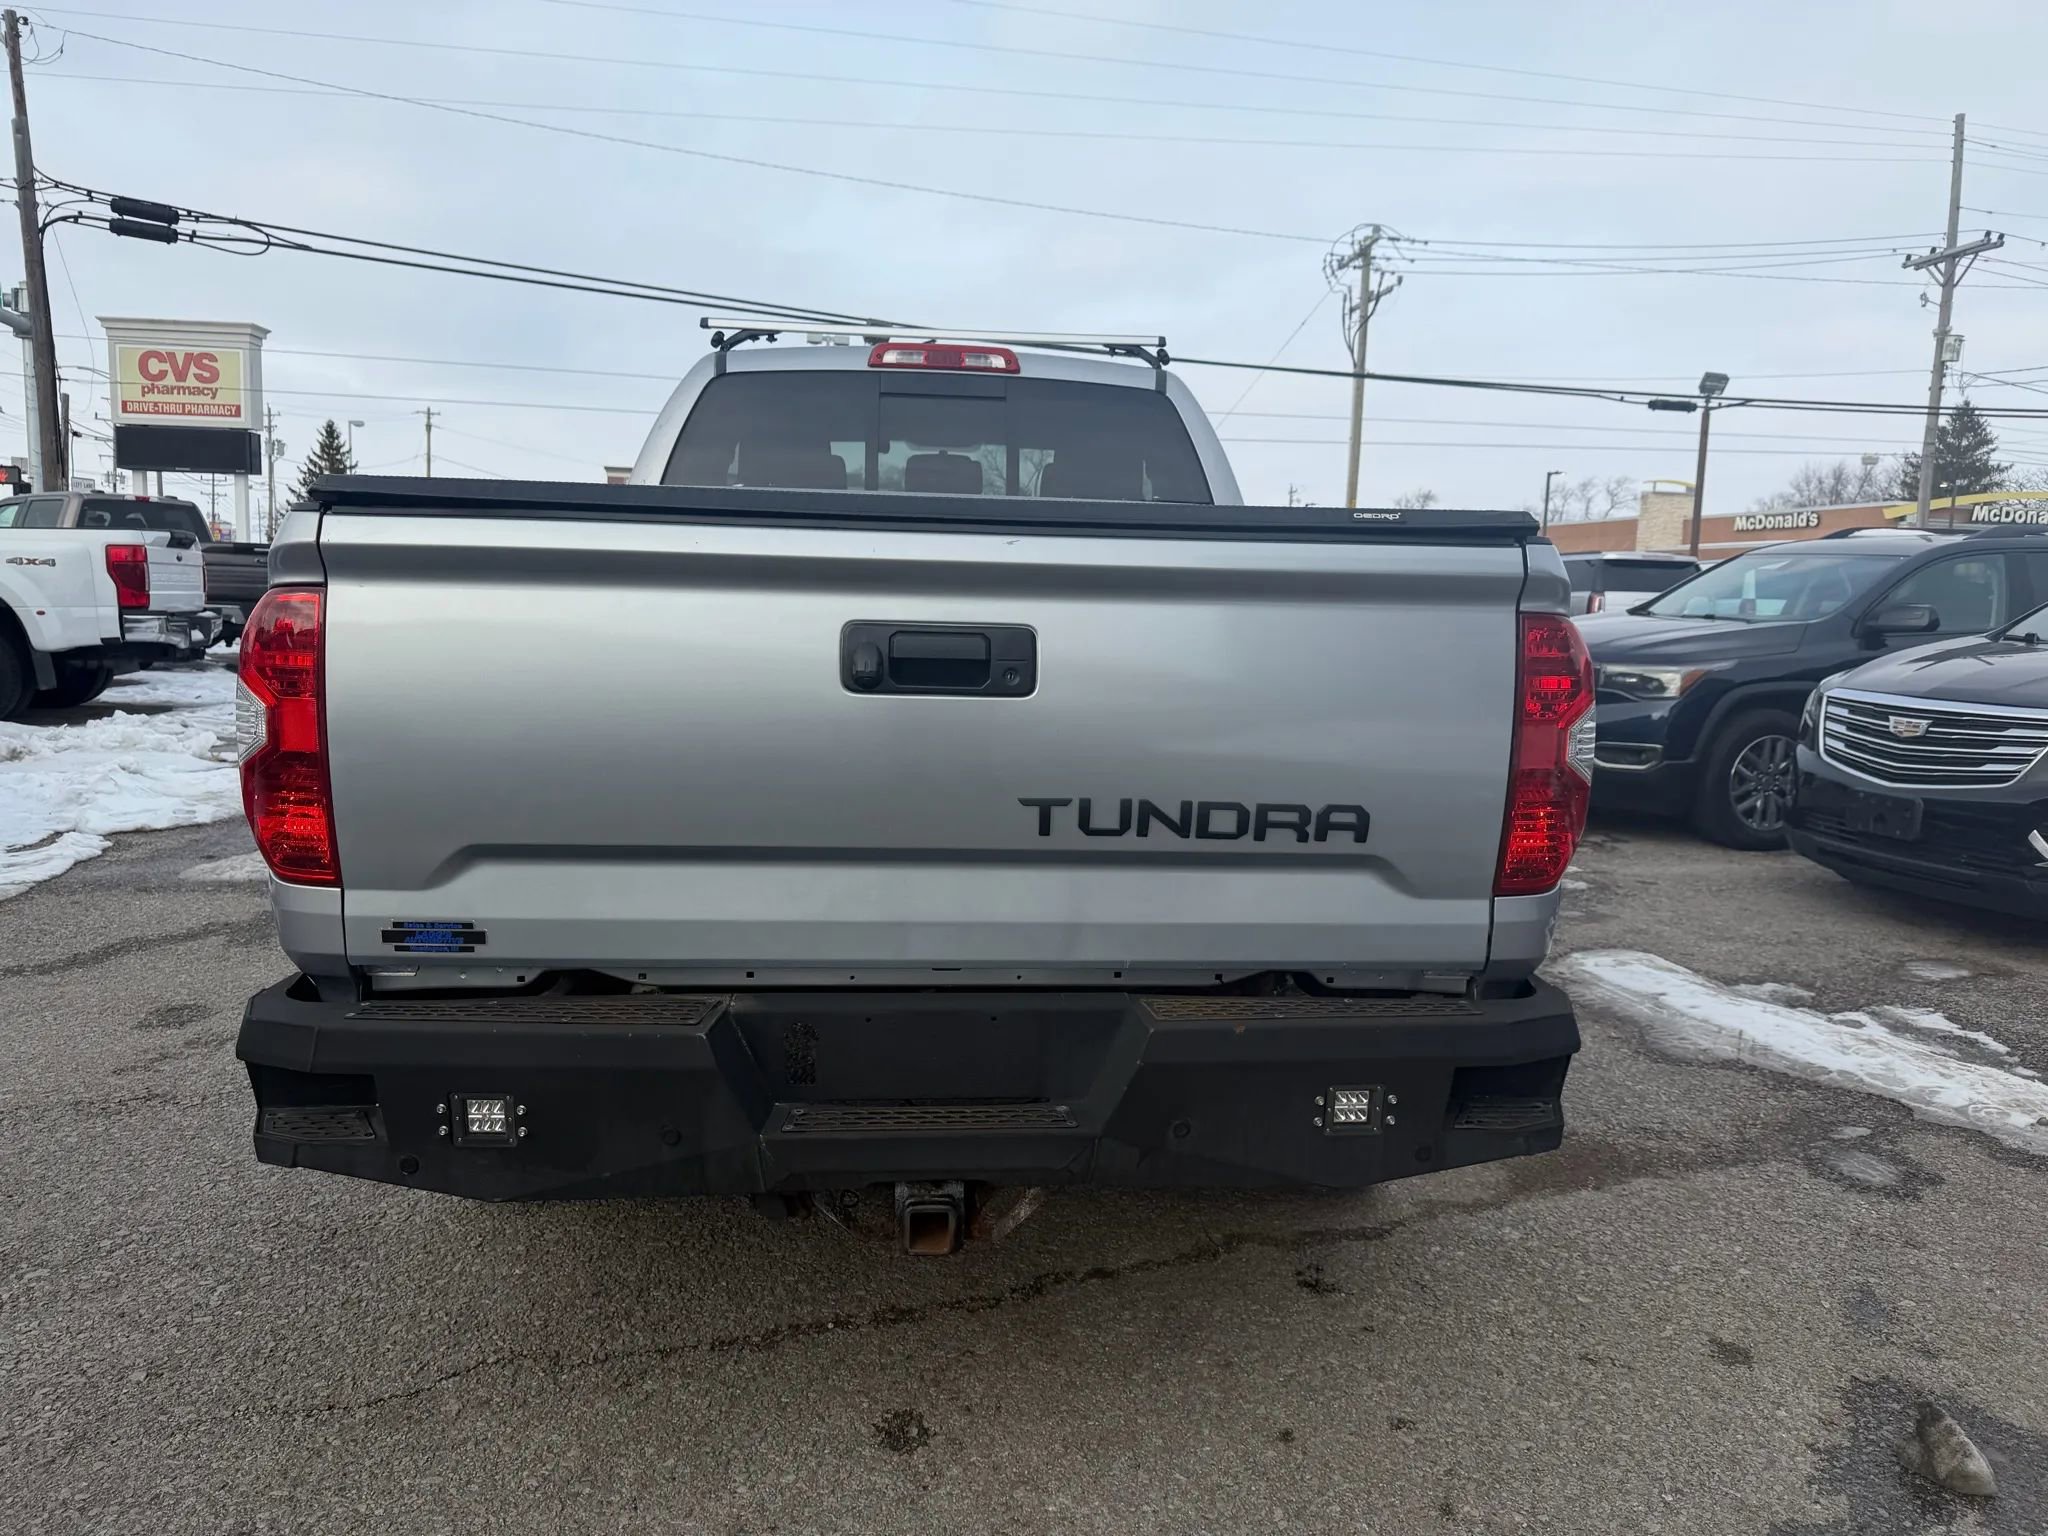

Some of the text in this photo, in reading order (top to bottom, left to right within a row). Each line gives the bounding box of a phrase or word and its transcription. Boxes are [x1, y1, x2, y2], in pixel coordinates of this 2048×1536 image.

[138, 350, 220, 384] CVS
[141, 383, 219, 400] pharmacy
[127, 401, 237, 416] DRIVE-THRU PHARMACY
[1733, 511, 1820, 532] McDonald's
[1017, 797, 1371, 844] TUNDRA
